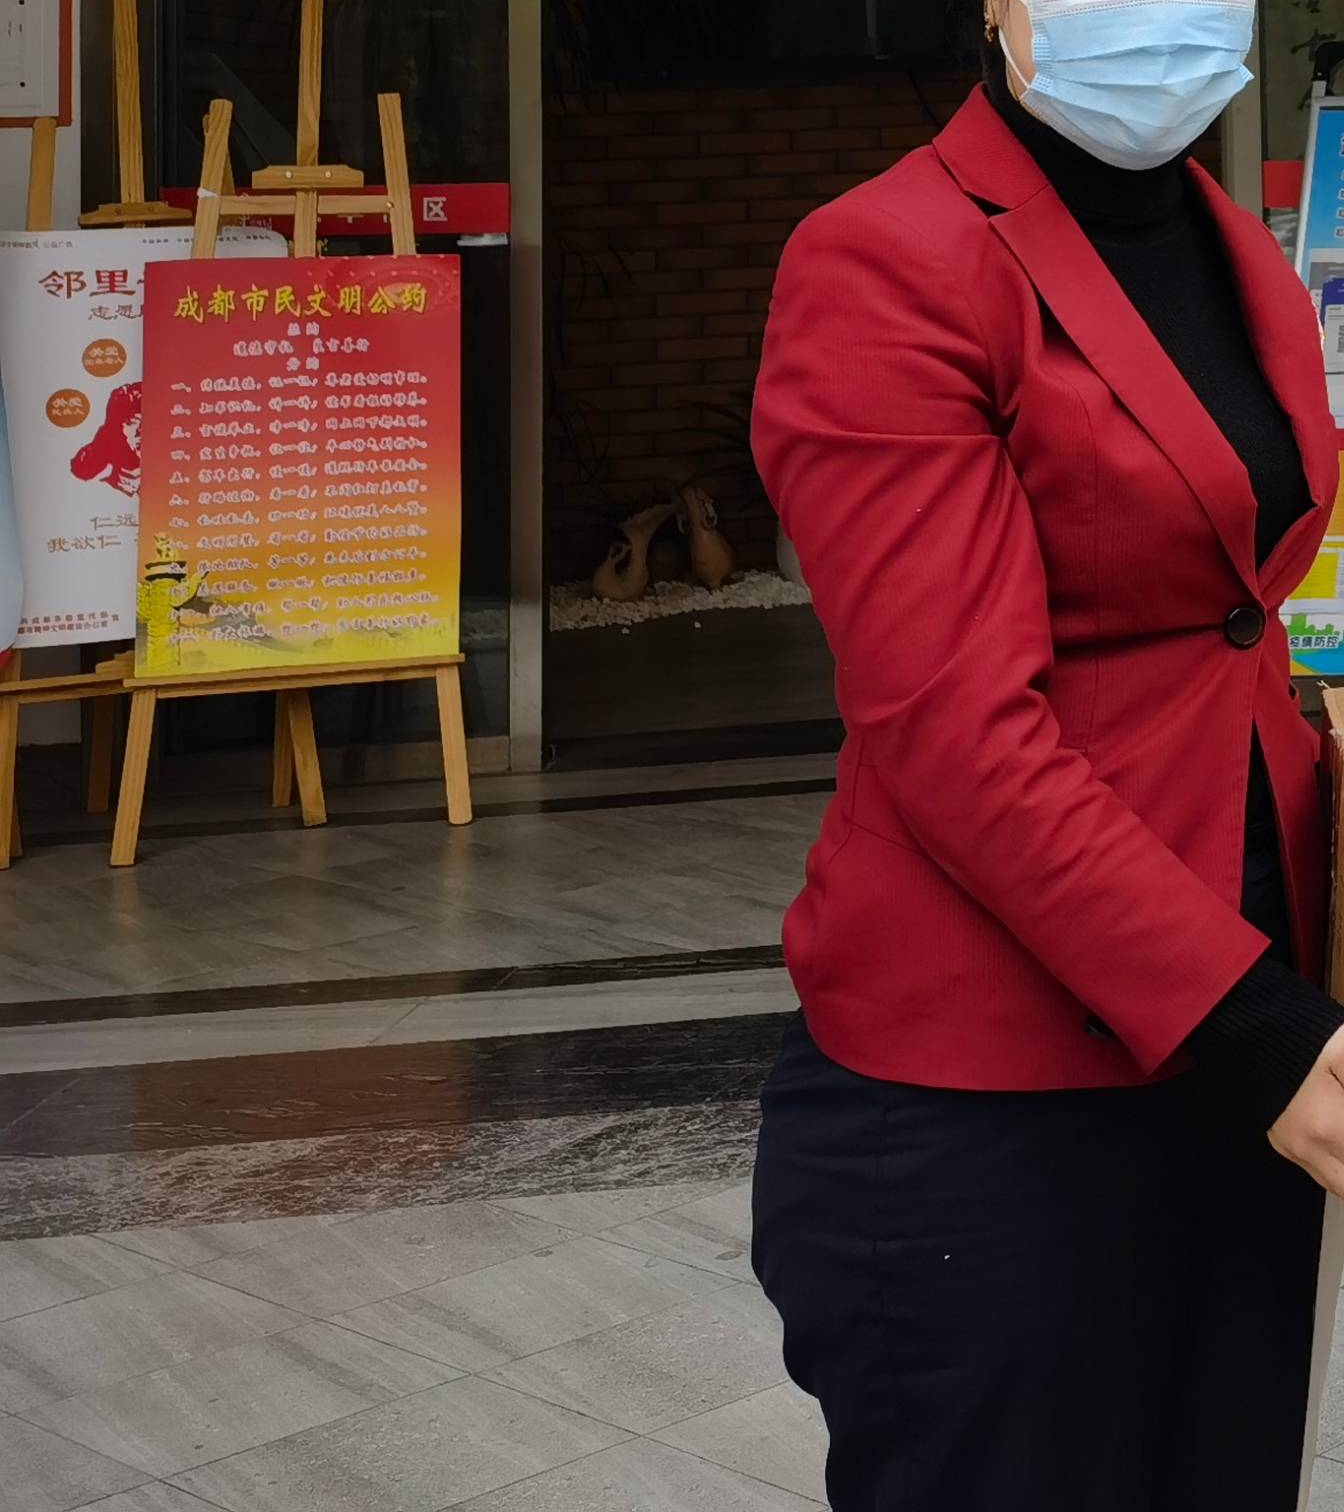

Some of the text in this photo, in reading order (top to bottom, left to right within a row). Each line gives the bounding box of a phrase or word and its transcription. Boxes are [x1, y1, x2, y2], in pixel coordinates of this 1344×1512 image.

[39, 269, 144, 299] 邻里
[88, 304, 143, 320] 志愿
[174, 282, 427, 323] 成都市民文明公约
